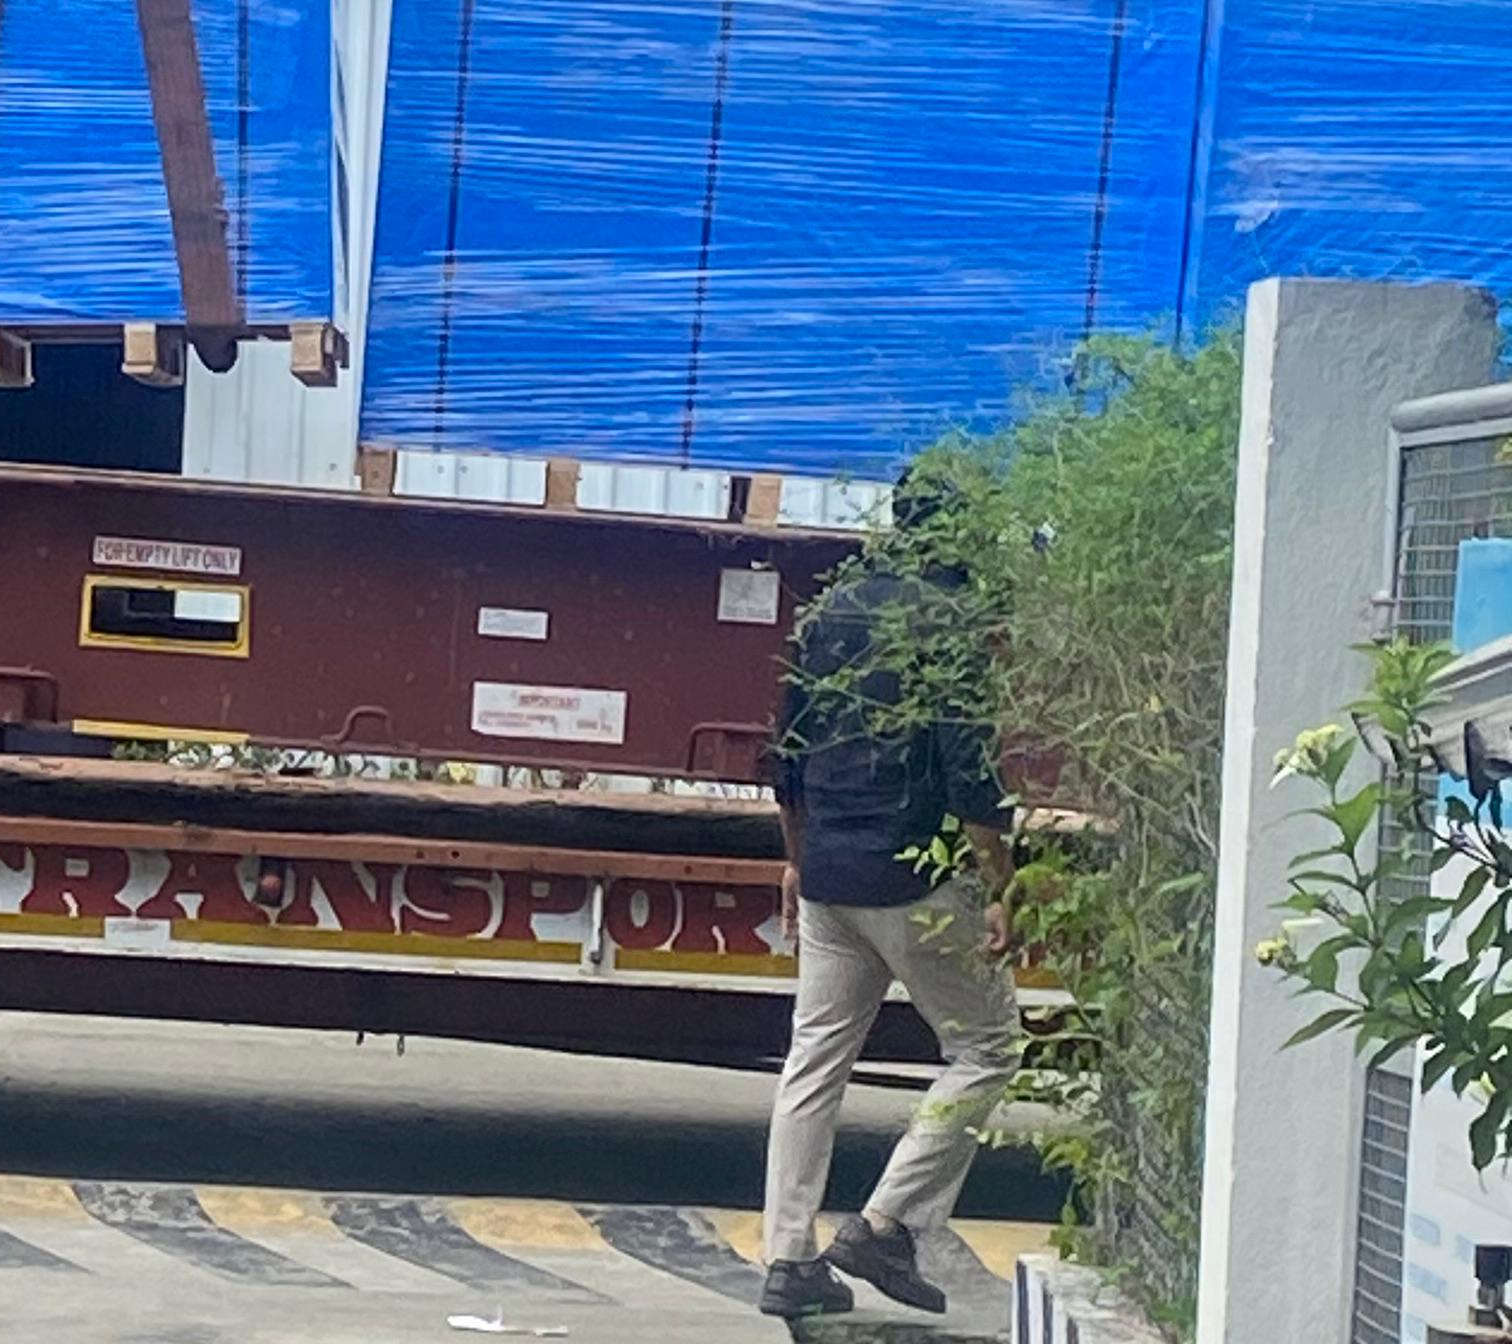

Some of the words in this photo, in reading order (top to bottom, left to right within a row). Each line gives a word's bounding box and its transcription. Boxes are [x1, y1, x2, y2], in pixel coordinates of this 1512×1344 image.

[96, 539, 123, 561] FOR
[124, 542, 171, 565] EMPTY
[171, 545, 202, 568] LIFT
